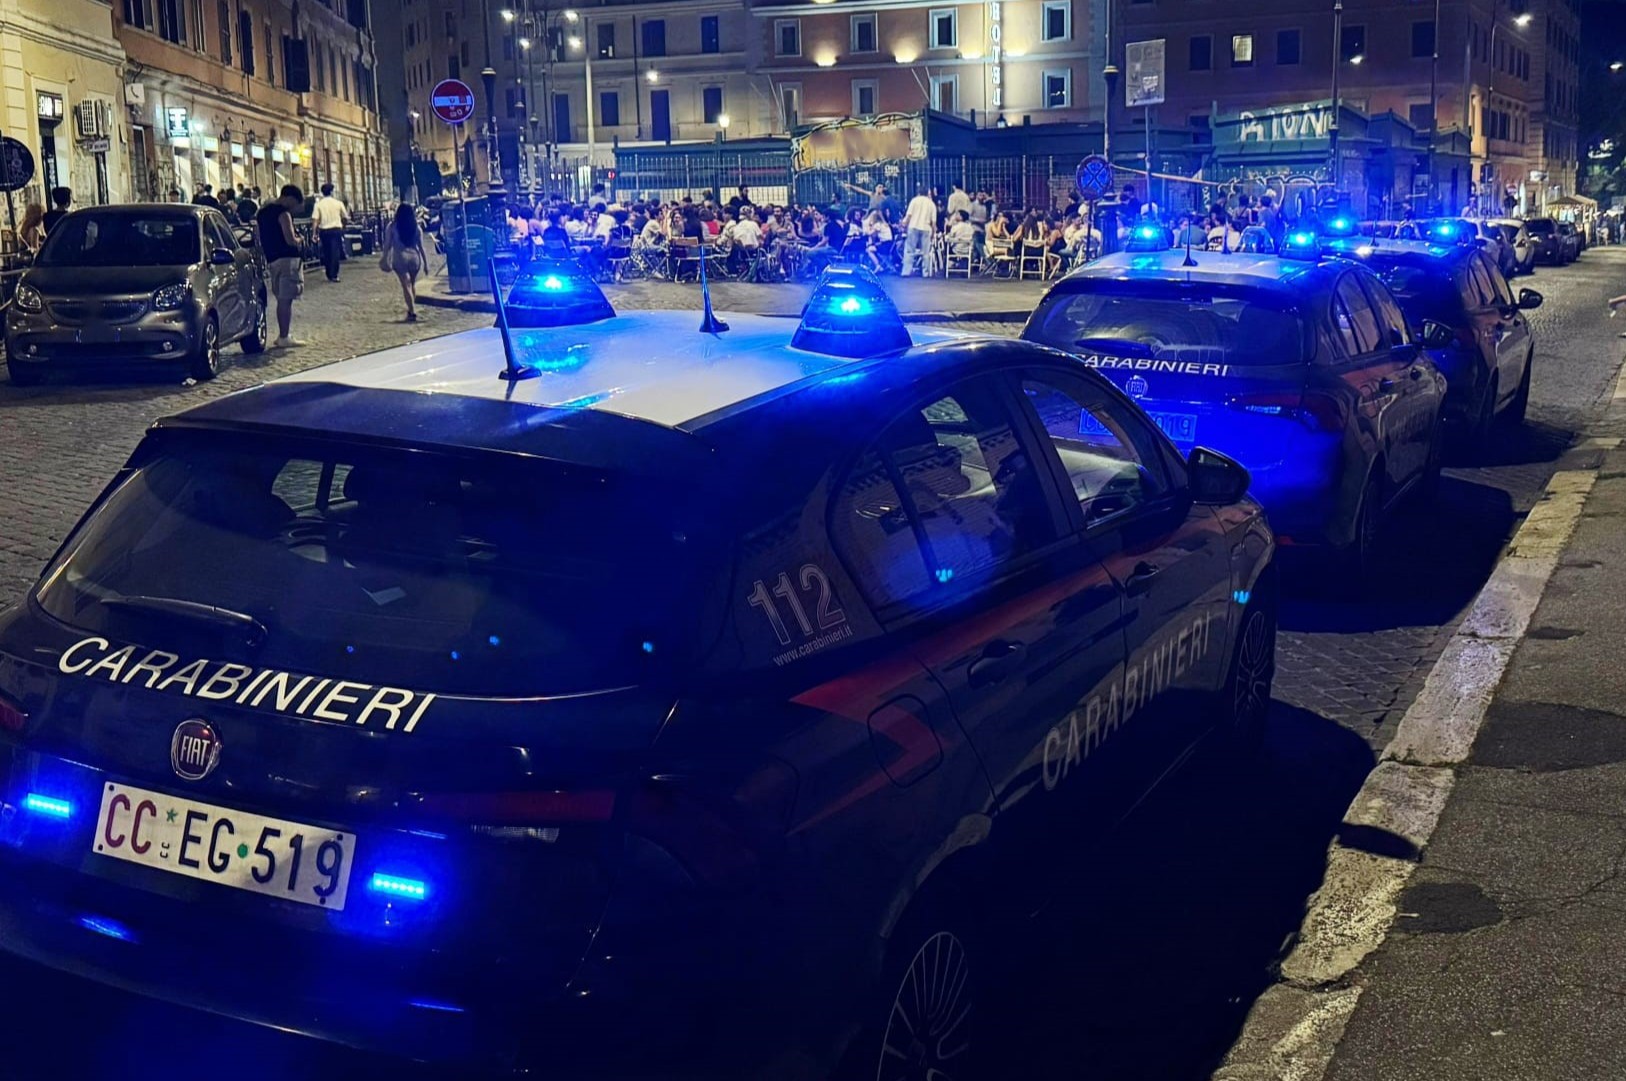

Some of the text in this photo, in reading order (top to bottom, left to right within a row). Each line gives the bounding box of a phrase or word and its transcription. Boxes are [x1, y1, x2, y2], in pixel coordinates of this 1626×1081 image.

[747, 563, 846, 645] 112
[773, 624, 853, 666] www.carabinieri.it
[58, 637, 435, 733] CARABINIERI
[1042, 611, 1210, 791] CARABINIERI
[180, 735, 210, 767] FIAT
[105, 794, 344, 898] CC EG 519
